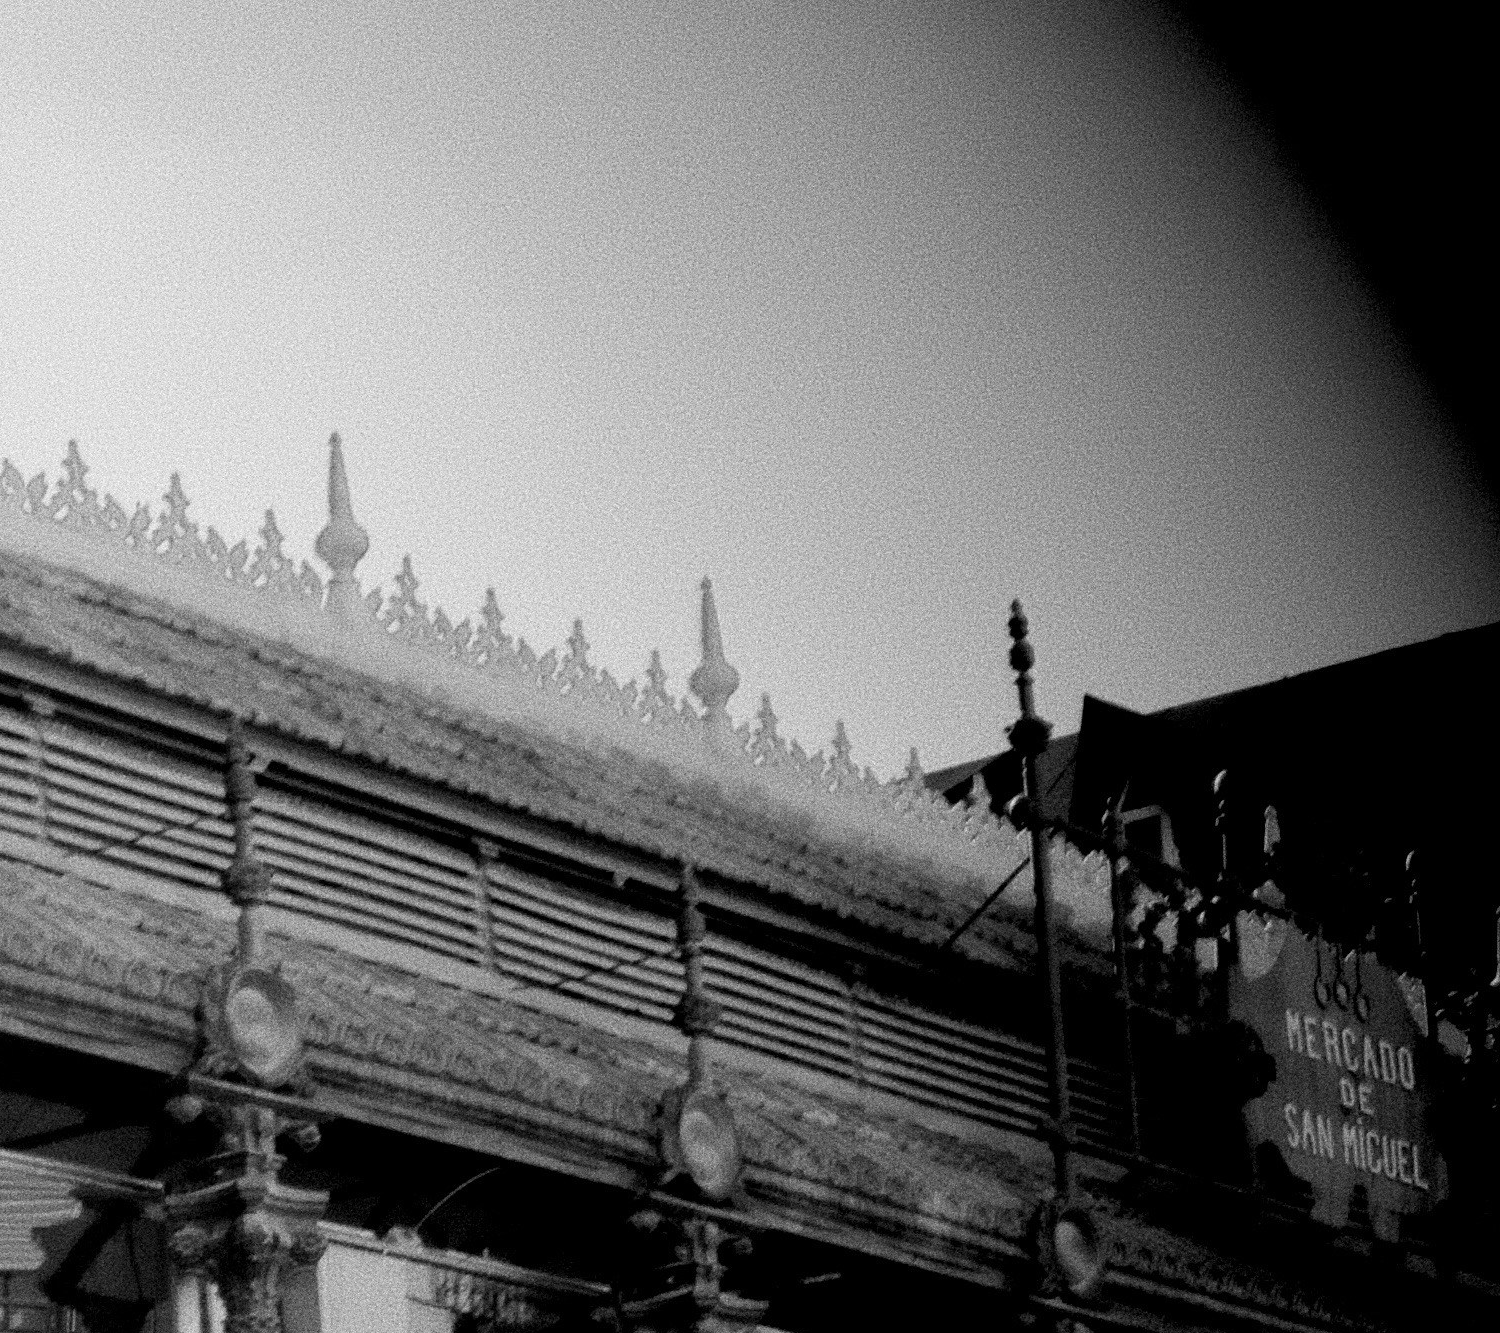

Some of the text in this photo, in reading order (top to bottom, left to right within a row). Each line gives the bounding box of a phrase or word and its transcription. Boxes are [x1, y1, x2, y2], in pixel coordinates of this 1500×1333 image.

[1285, 1008, 1416, 1091] MERCADO
[1339, 1077, 1376, 1116] DE
[1285, 1103, 1335, 1160] SAN
